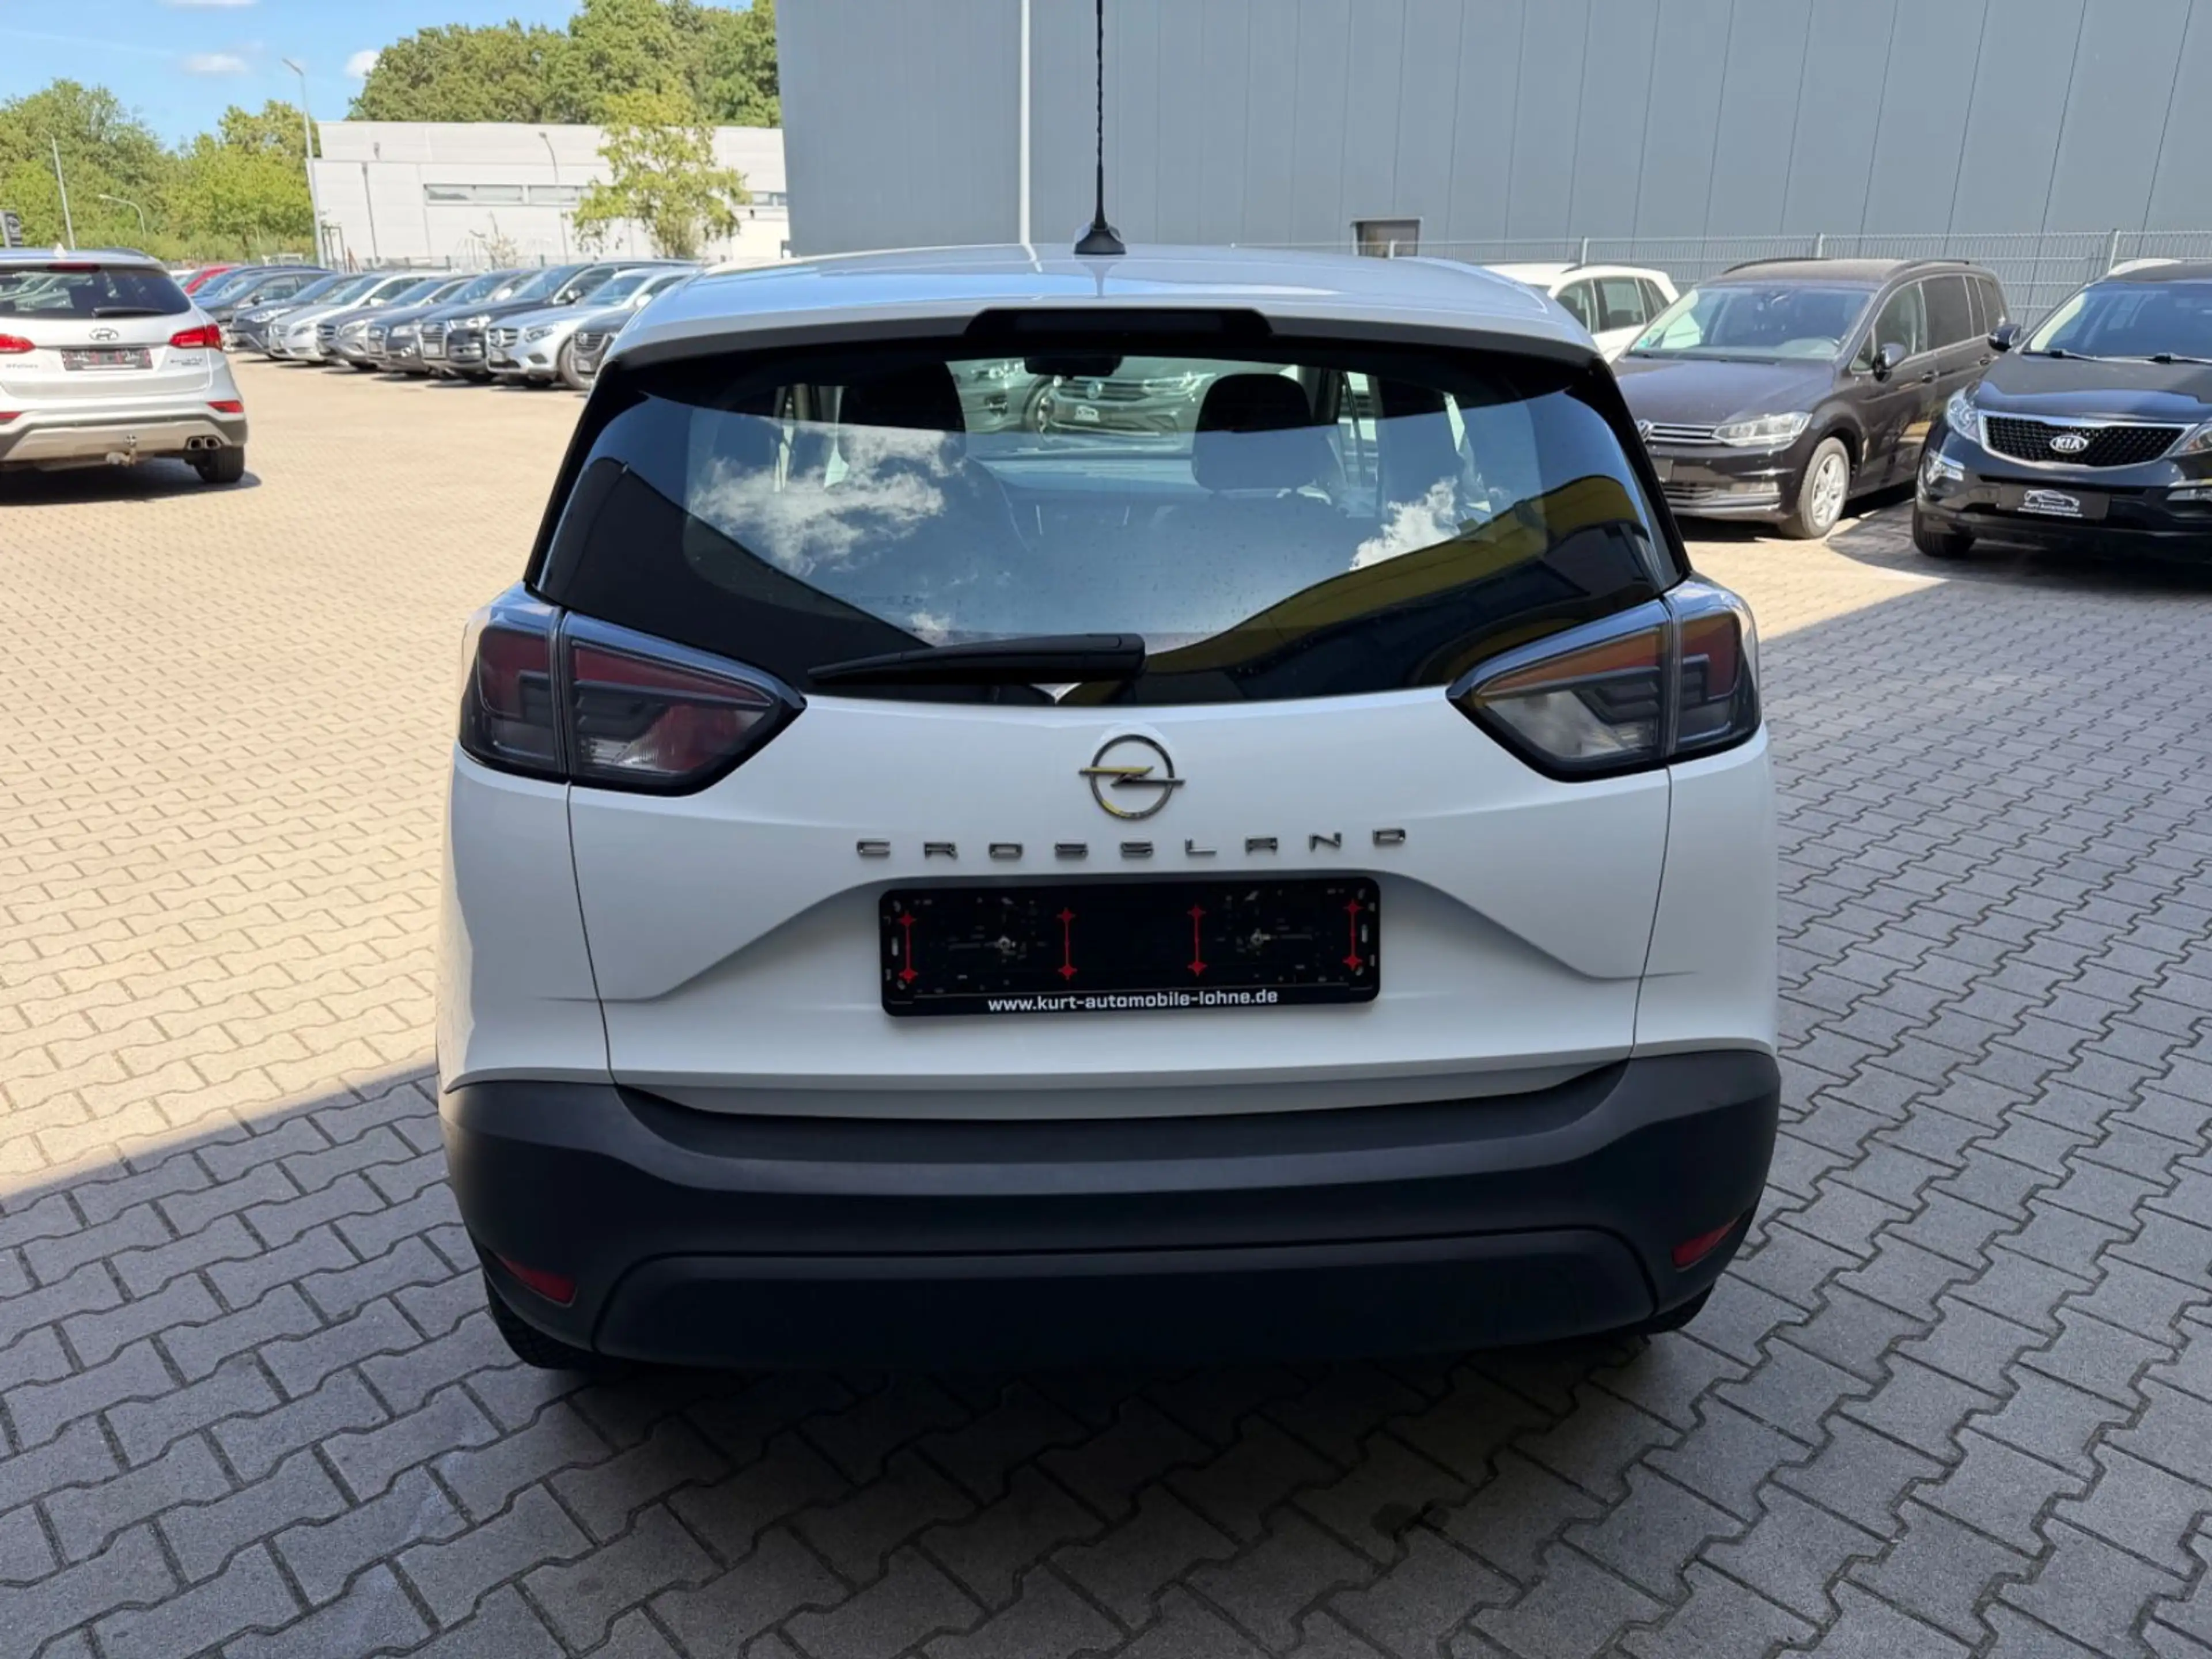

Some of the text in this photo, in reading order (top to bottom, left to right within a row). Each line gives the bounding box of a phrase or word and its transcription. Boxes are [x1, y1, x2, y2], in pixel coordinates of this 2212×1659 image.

[2055, 437, 2080, 449] KIA
[857, 828, 1406, 859] CROSSLAND
[988, 988, 1278, 1012] www.kurt-automobile-lohne.de
